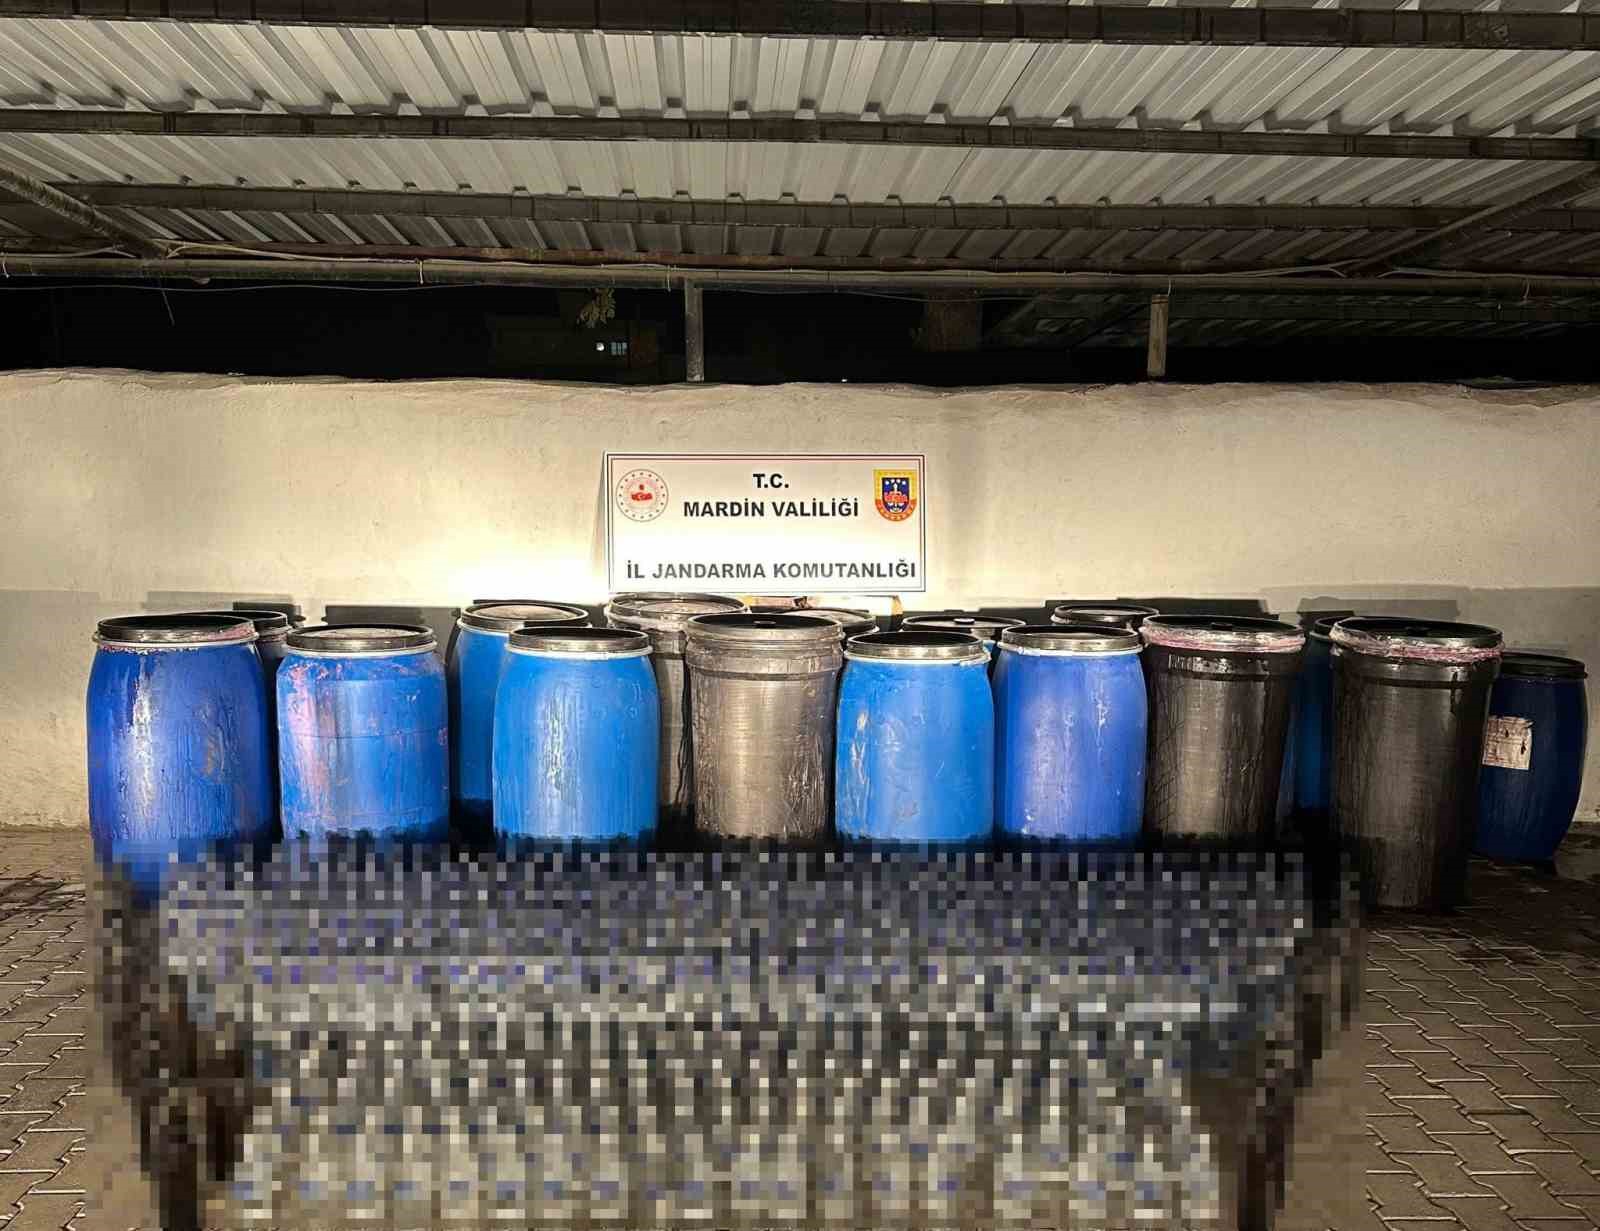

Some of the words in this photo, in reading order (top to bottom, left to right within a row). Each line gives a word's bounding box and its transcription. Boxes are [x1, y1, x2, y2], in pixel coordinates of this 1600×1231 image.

[752, 473, 790, 489] T.C.
[683, 498, 765, 517] MARDİN
[771, 497, 859, 517] VALİLİĞİ
[627, 560, 645, 579] İL
[652, 562, 766, 579] JANDARMA
[773, 559, 916, 578] KOMUTANLIĞI
